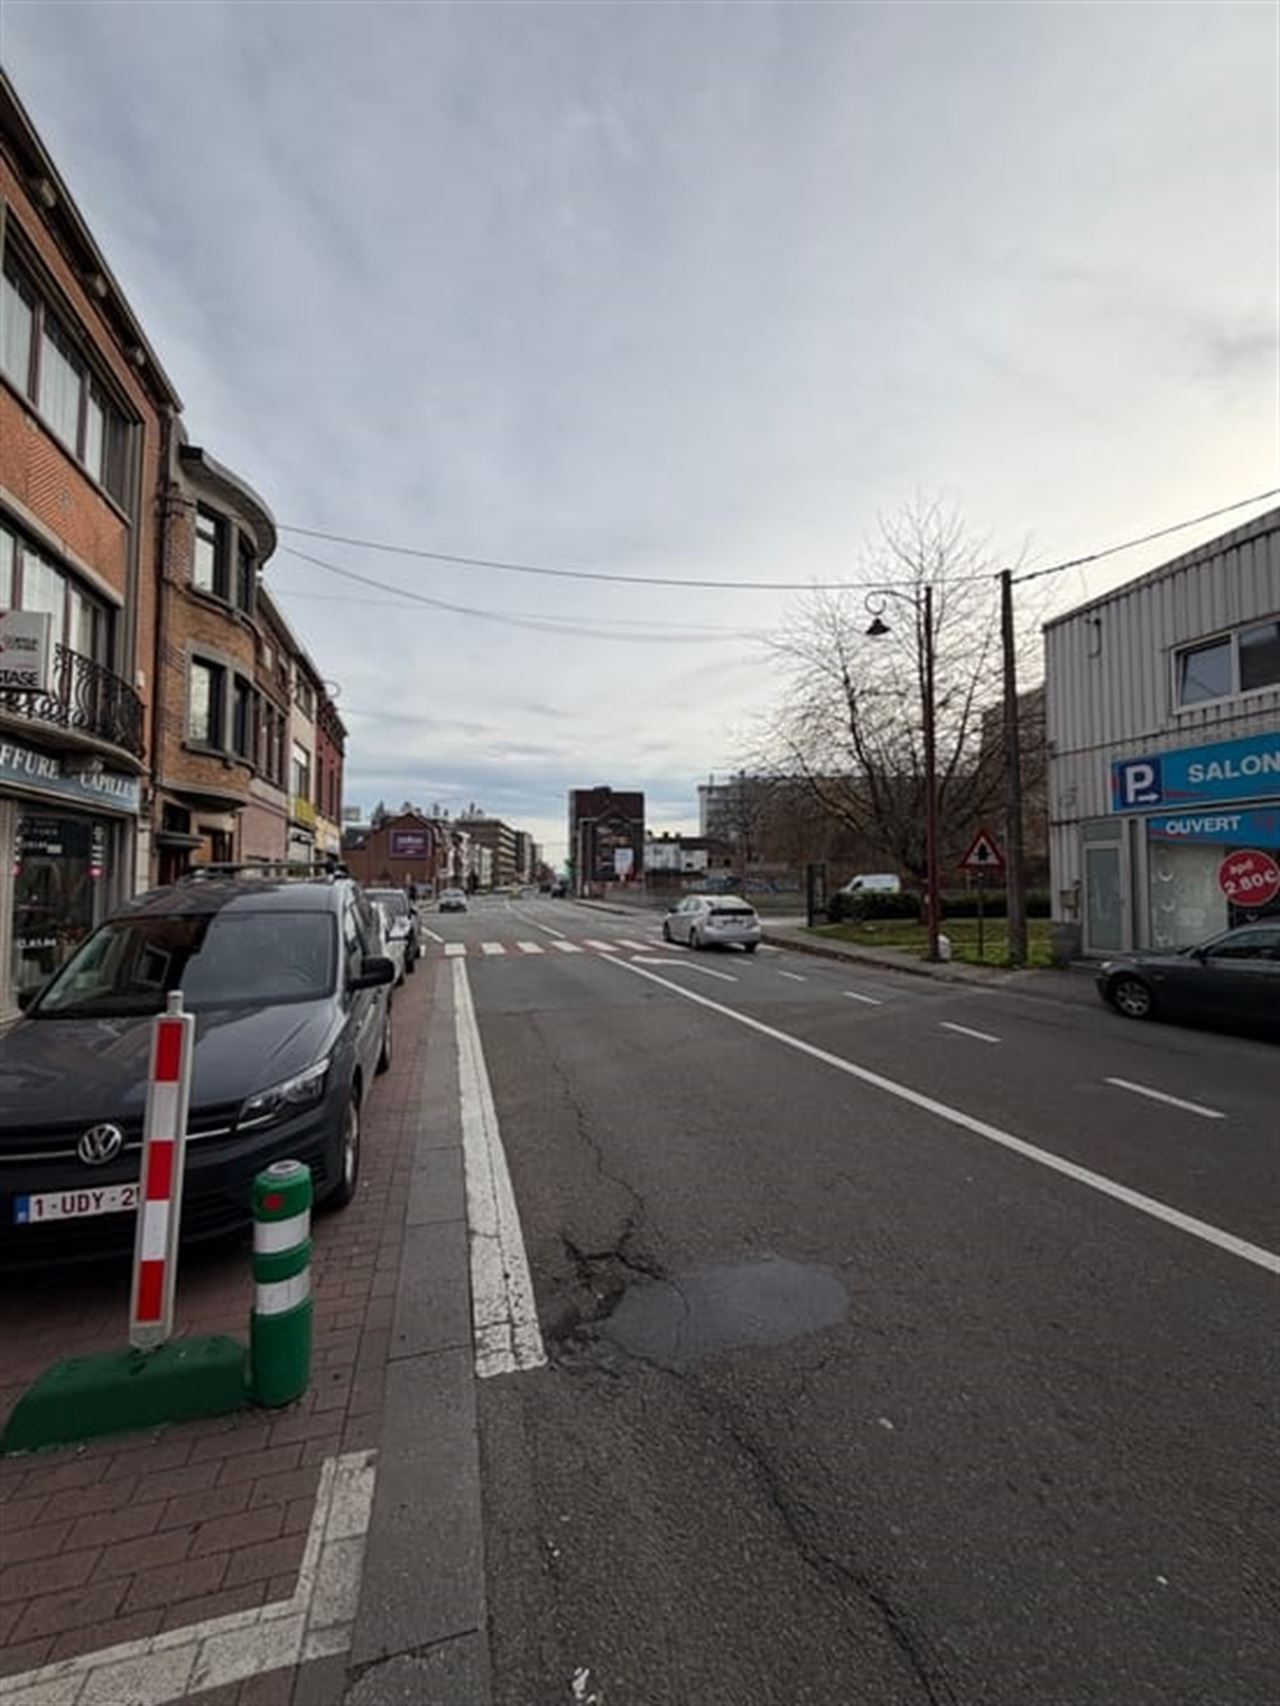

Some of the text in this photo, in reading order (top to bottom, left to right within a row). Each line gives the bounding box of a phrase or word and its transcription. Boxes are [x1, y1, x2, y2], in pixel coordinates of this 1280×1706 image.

[1188, 752, 1280, 783] SALON
[80, 772, 136, 798] CAPILL
[1126, 764, 1154, 803] P
[1165, 815, 1241, 835] OUVERT
